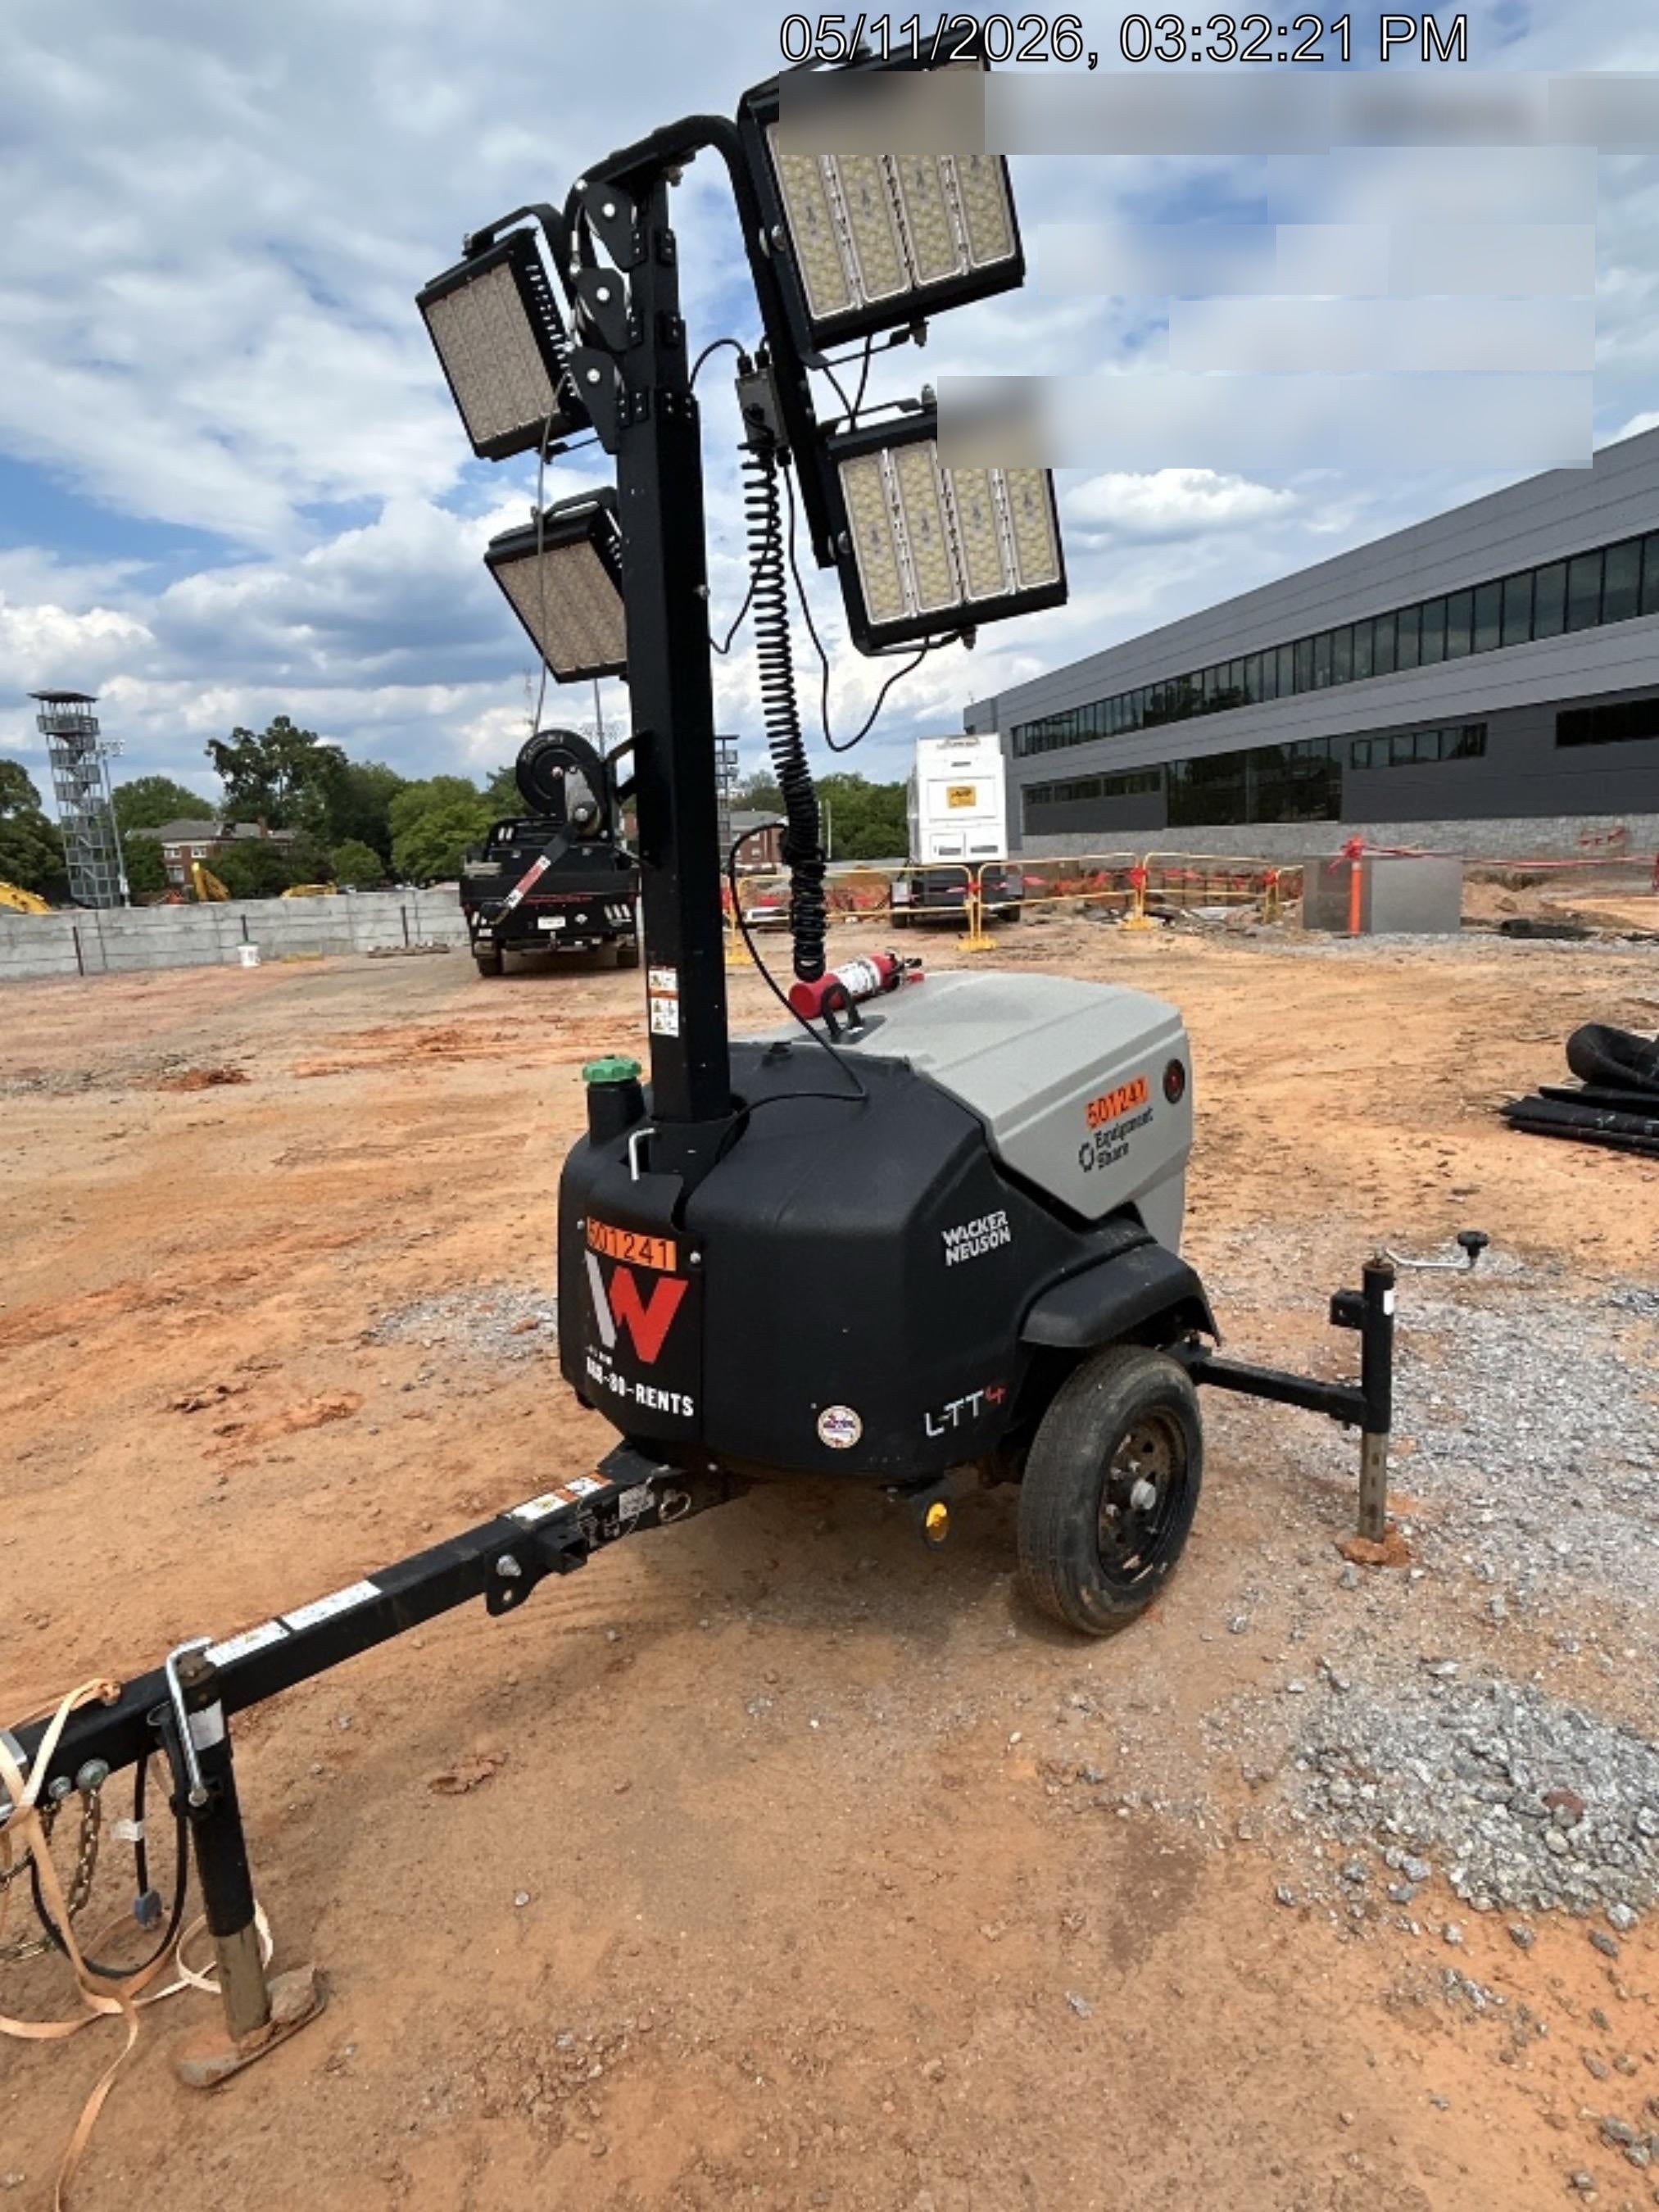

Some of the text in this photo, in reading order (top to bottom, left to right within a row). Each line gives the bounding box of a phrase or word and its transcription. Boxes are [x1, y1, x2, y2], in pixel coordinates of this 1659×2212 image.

[1086, 1079, 1145, 1129] 501241
[941, 1210, 1009, 1247] WACKER
[945, 1226, 1011, 1267] NEUSON
